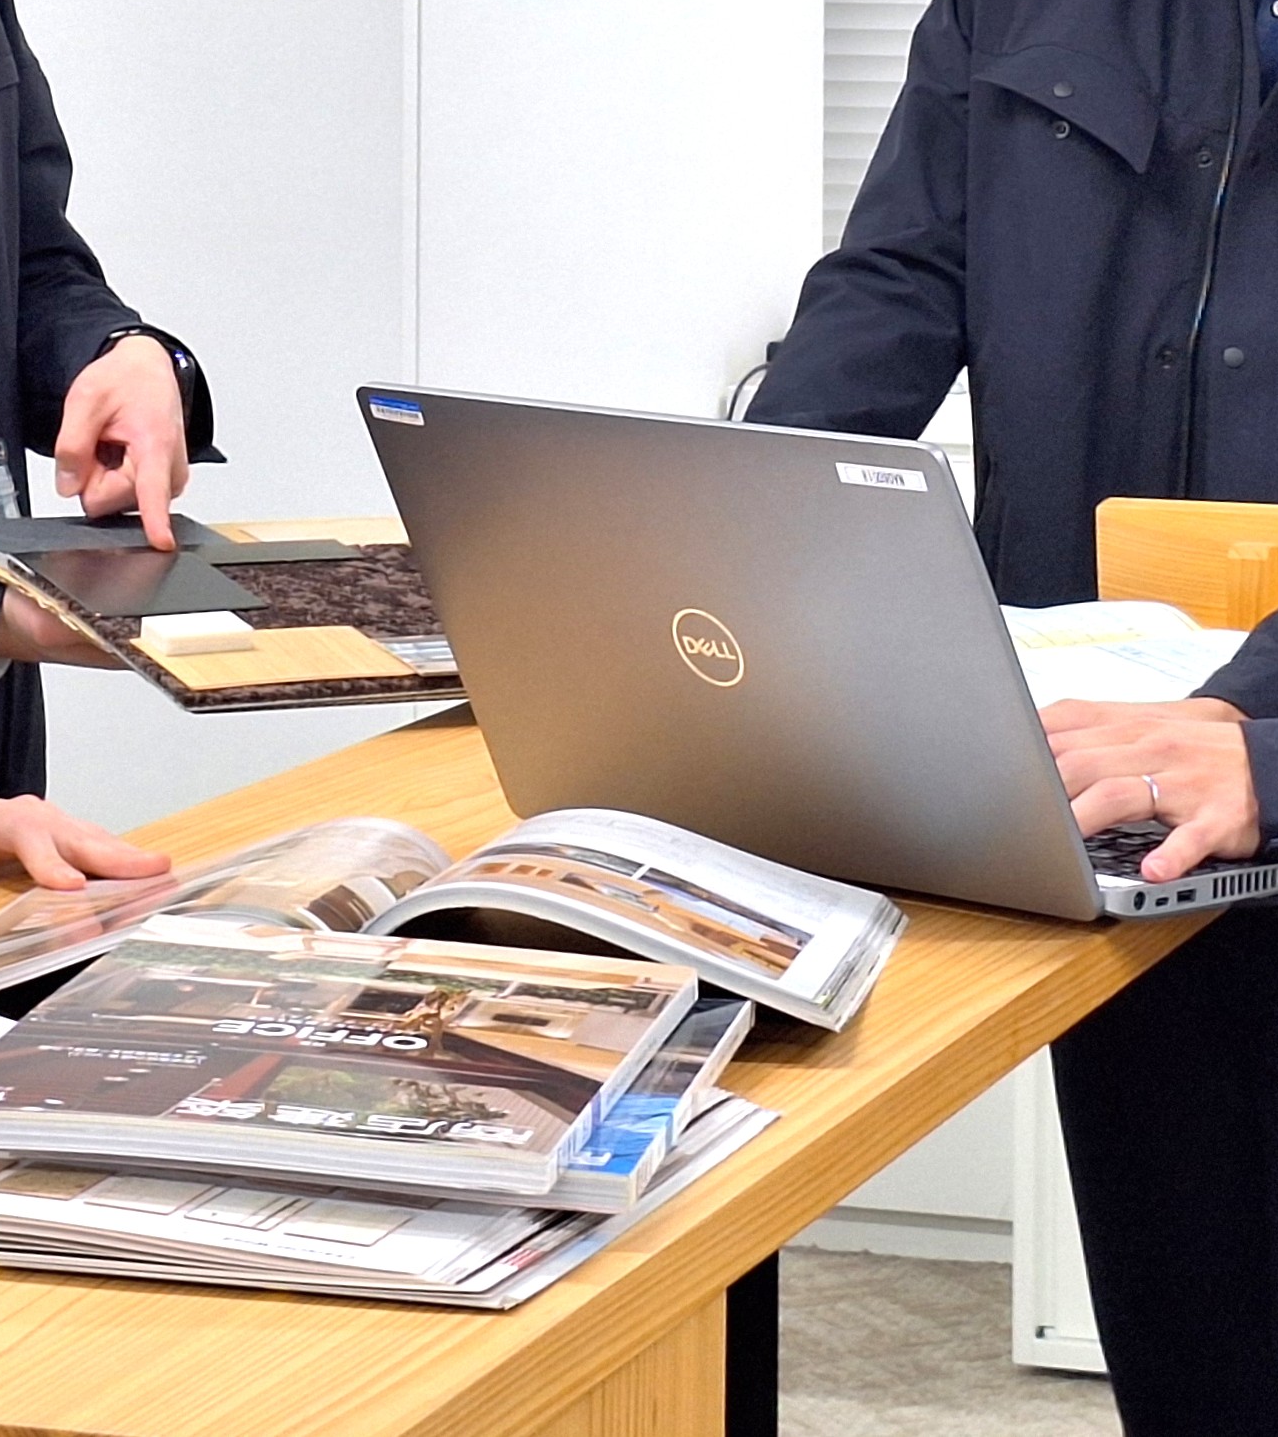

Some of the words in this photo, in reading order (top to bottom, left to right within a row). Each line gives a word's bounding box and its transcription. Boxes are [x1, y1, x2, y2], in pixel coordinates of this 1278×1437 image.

[682, 635, 737, 660] DELL
[212, 1019, 428, 1050] OFFICE
[176, 1098, 534, 1144] 商店建築
